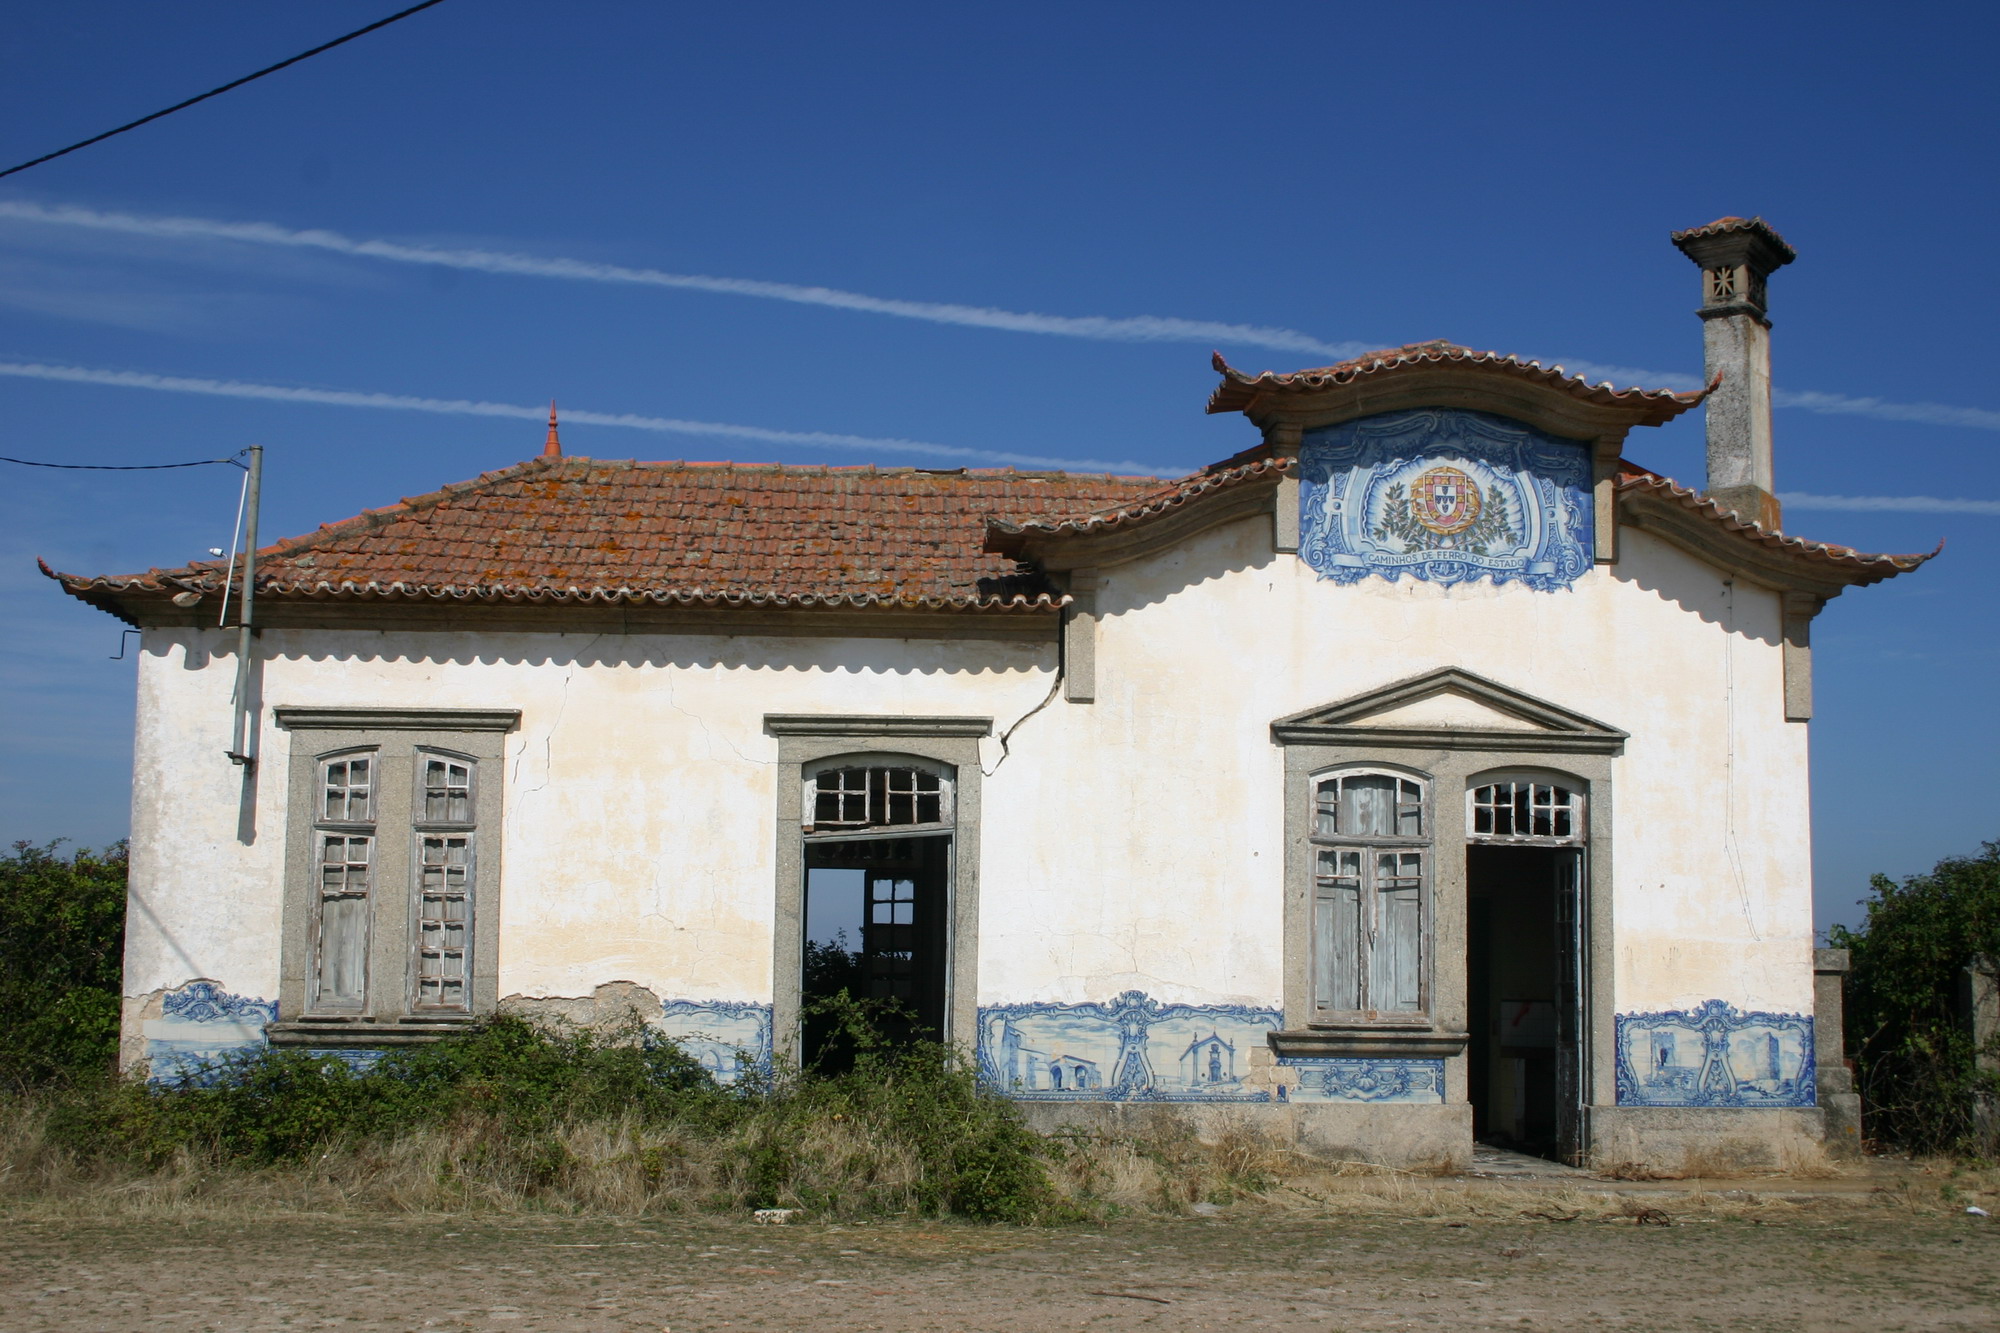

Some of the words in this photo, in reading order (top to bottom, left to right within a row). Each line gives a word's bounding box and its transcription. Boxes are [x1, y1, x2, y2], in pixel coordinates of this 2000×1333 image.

[1368, 553, 1418, 564] CAMINHOS
[1422, 551, 1434, 560] DE
[1437, 551, 1468, 560] FERRO
[1472, 555, 1485, 564] DO
[1488, 559, 1525, 567] ESTADO
